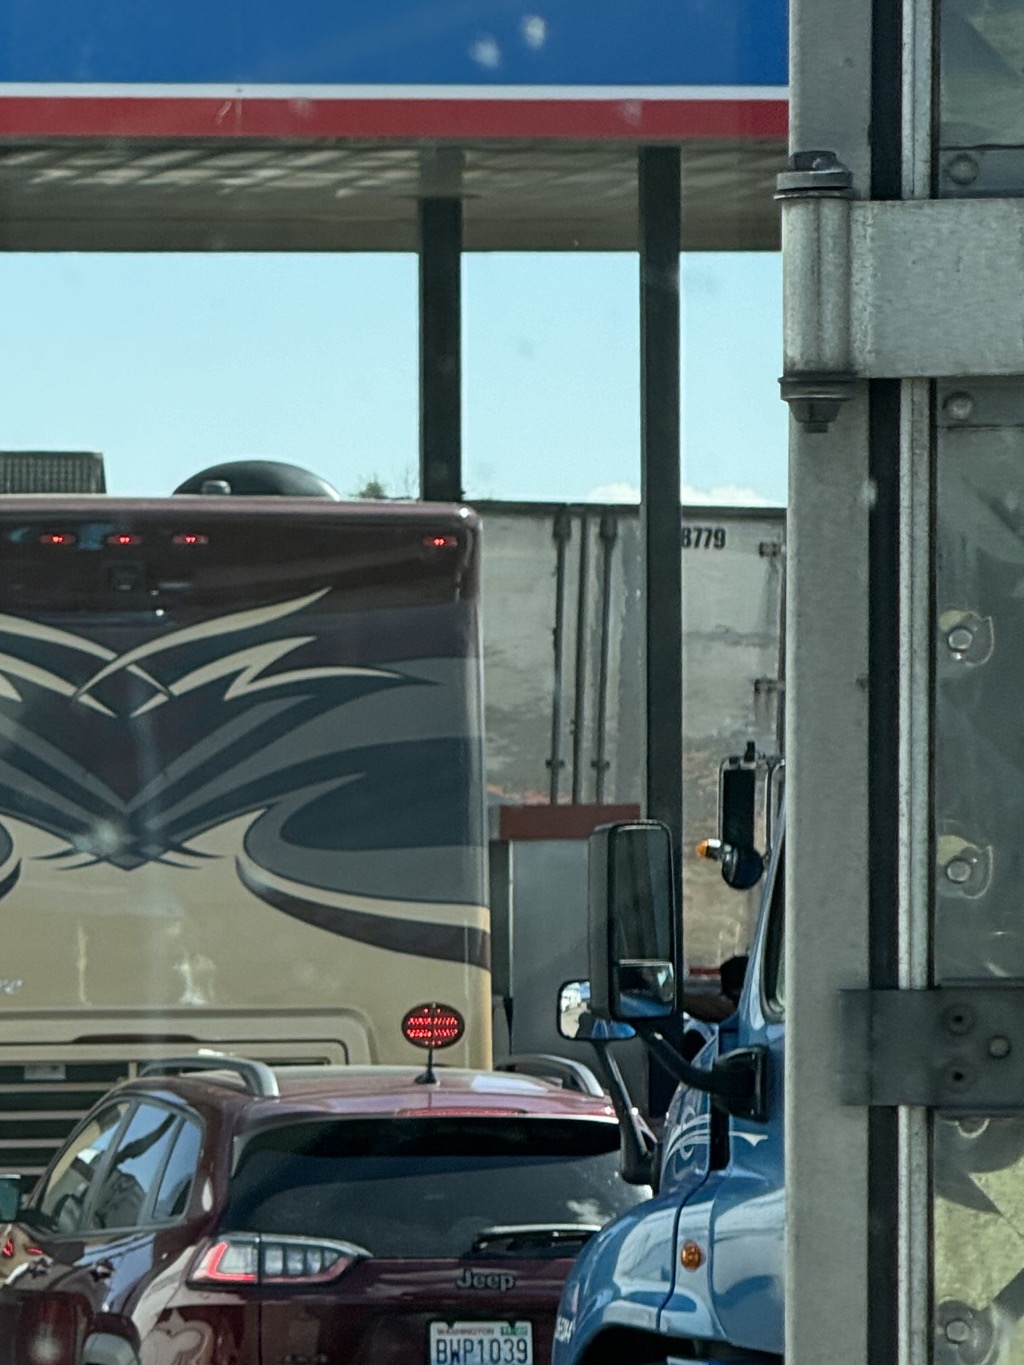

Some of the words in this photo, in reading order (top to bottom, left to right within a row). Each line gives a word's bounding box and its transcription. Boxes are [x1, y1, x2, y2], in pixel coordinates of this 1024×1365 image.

[456, 1267, 516, 1294] Jeep
[436, 1326, 496, 1336] WASHINGTON
[436, 1338, 528, 1365] BWP1039
